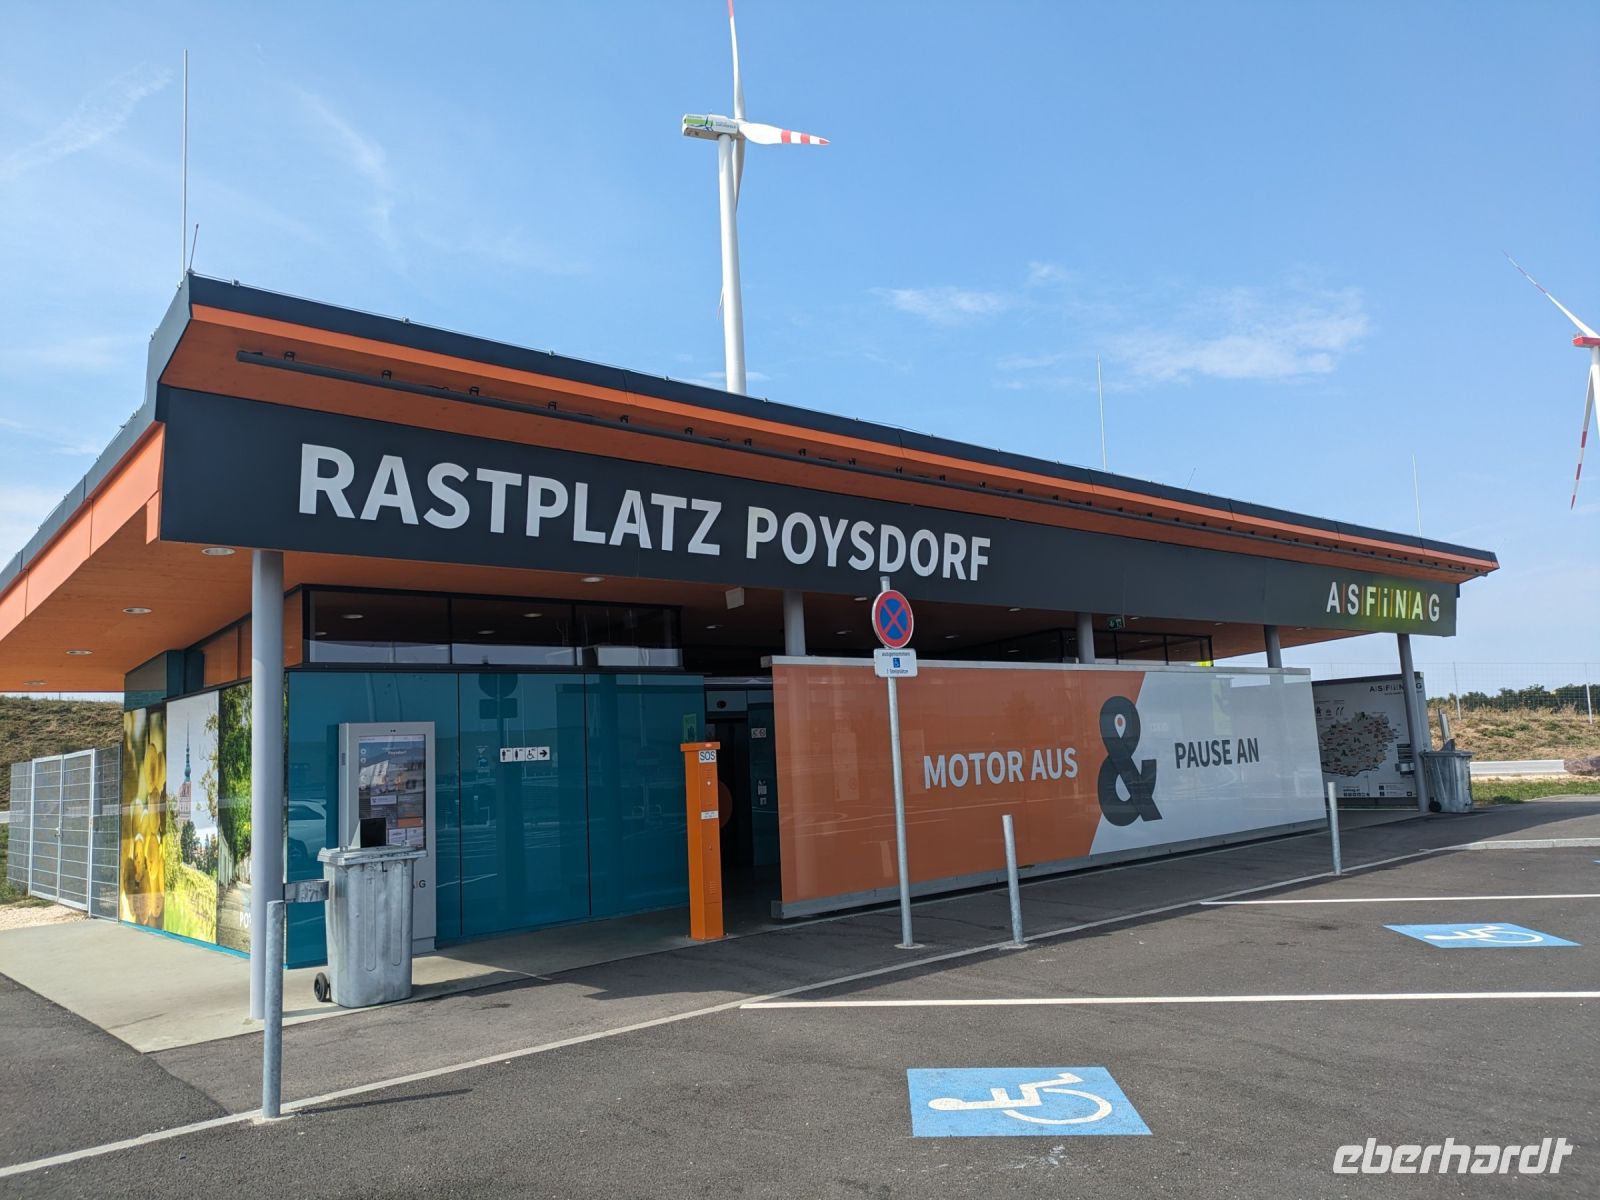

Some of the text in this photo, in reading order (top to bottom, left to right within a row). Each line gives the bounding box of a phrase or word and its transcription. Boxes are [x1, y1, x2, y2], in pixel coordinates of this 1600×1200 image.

[299, 442, 991, 581] RASTPLATZ POYSDORF
[700, 750, 716, 761] SOS
[923, 695, 1260, 827] MOTOR AUS & PAUSE AN
